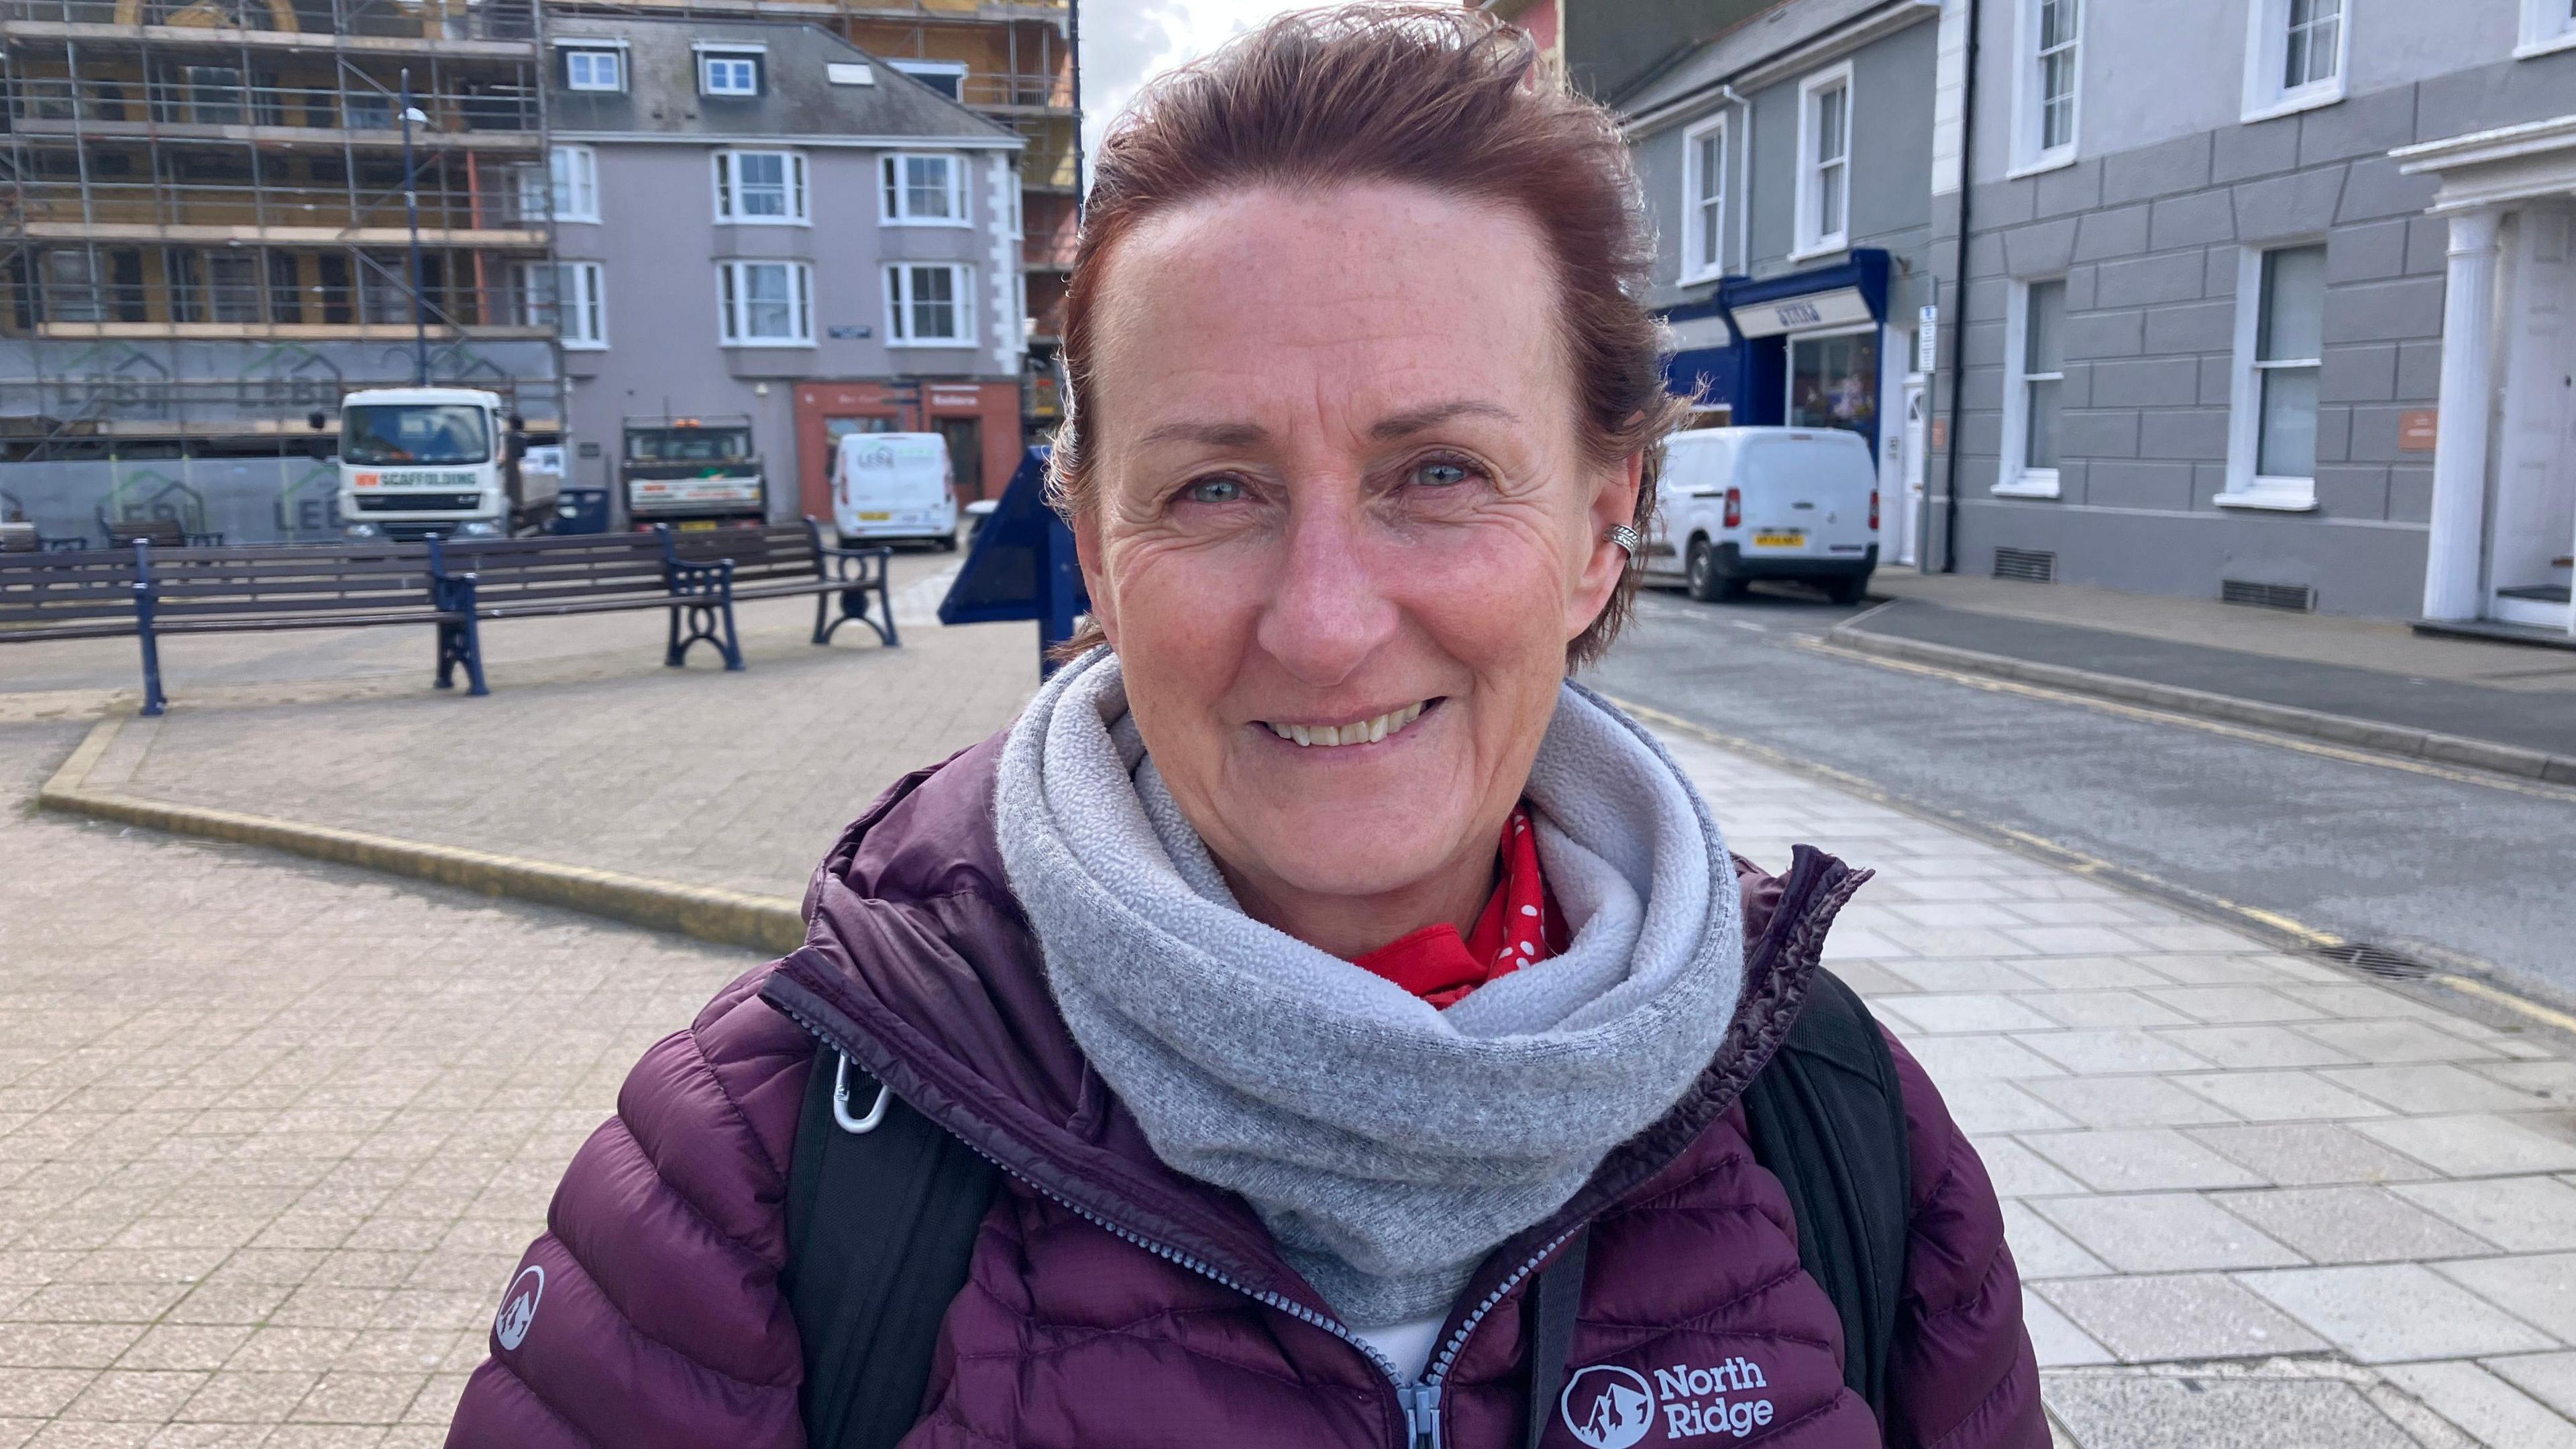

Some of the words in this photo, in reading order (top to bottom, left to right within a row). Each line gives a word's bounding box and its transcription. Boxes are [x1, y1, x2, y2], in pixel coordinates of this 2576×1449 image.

[380, 472, 476, 486] SCAFFOLDING
[1654, 1356, 1768, 1401] North
[1663, 1397, 1774, 1440] Ridge
